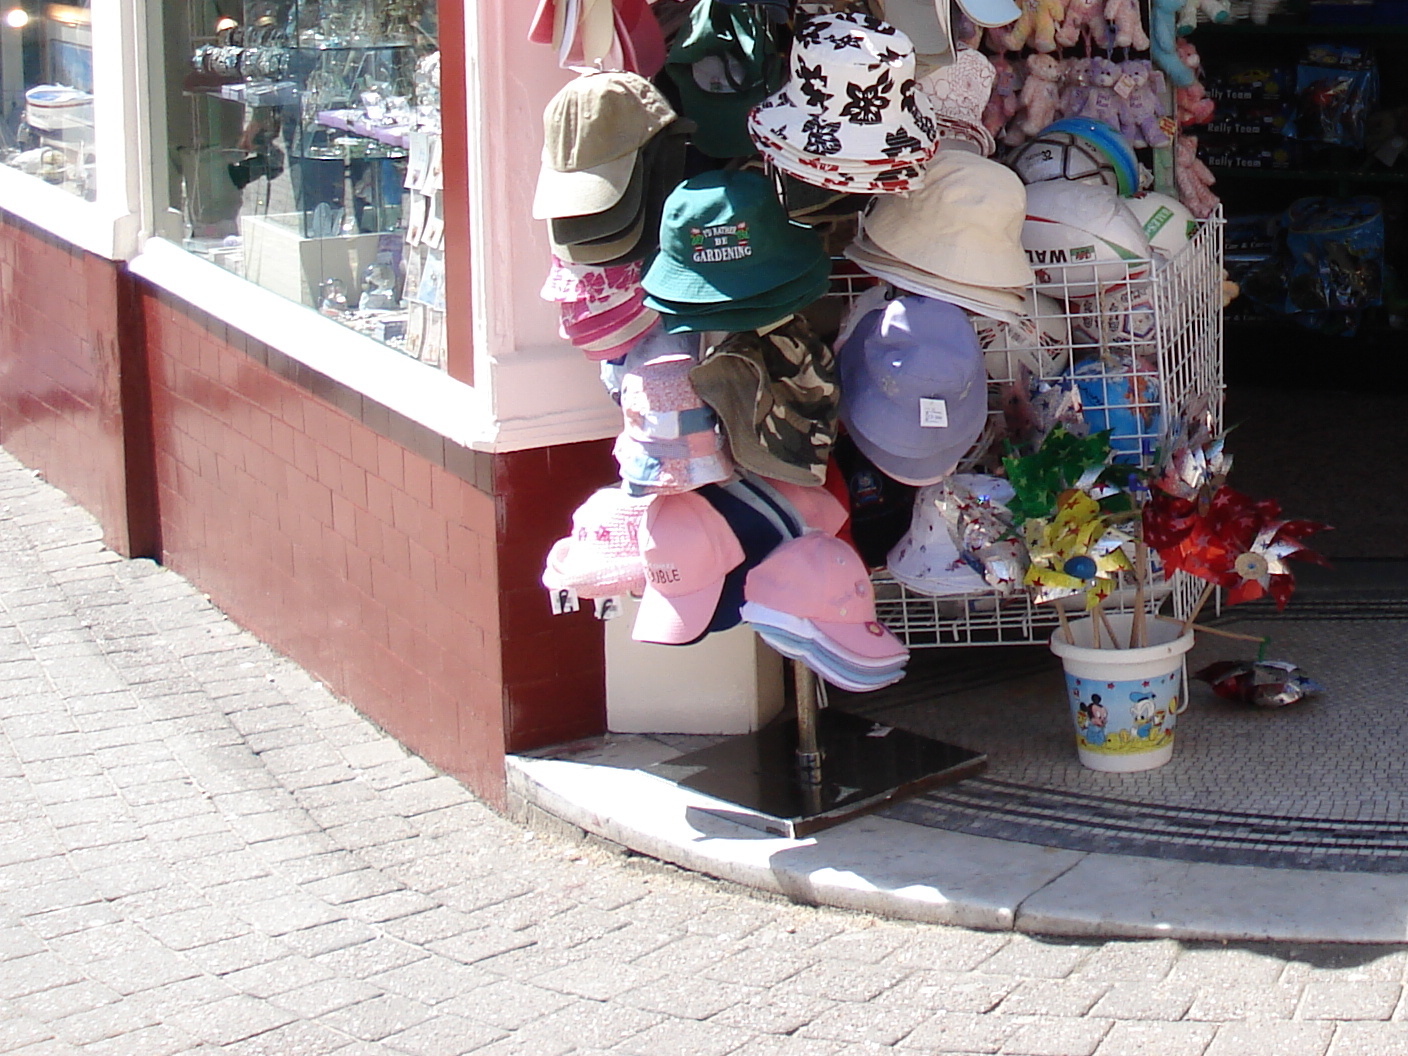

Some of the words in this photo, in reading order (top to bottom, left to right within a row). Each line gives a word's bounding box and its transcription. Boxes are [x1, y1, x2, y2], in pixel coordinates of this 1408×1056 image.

[1205, 88, 1222, 100] ally
[1227, 89, 1252, 100] Team
[1208, 122, 1231, 134] Rally
[1235, 123, 1260, 134] Team
[1041, 149, 1053, 161] 32
[1209, 155, 1232, 167] Rally
[1236, 157, 1261, 168] Team
[712, 225, 737, 236] RATHER
[714, 237, 728, 246] BE
[693, 246, 752, 262] GARDENING
